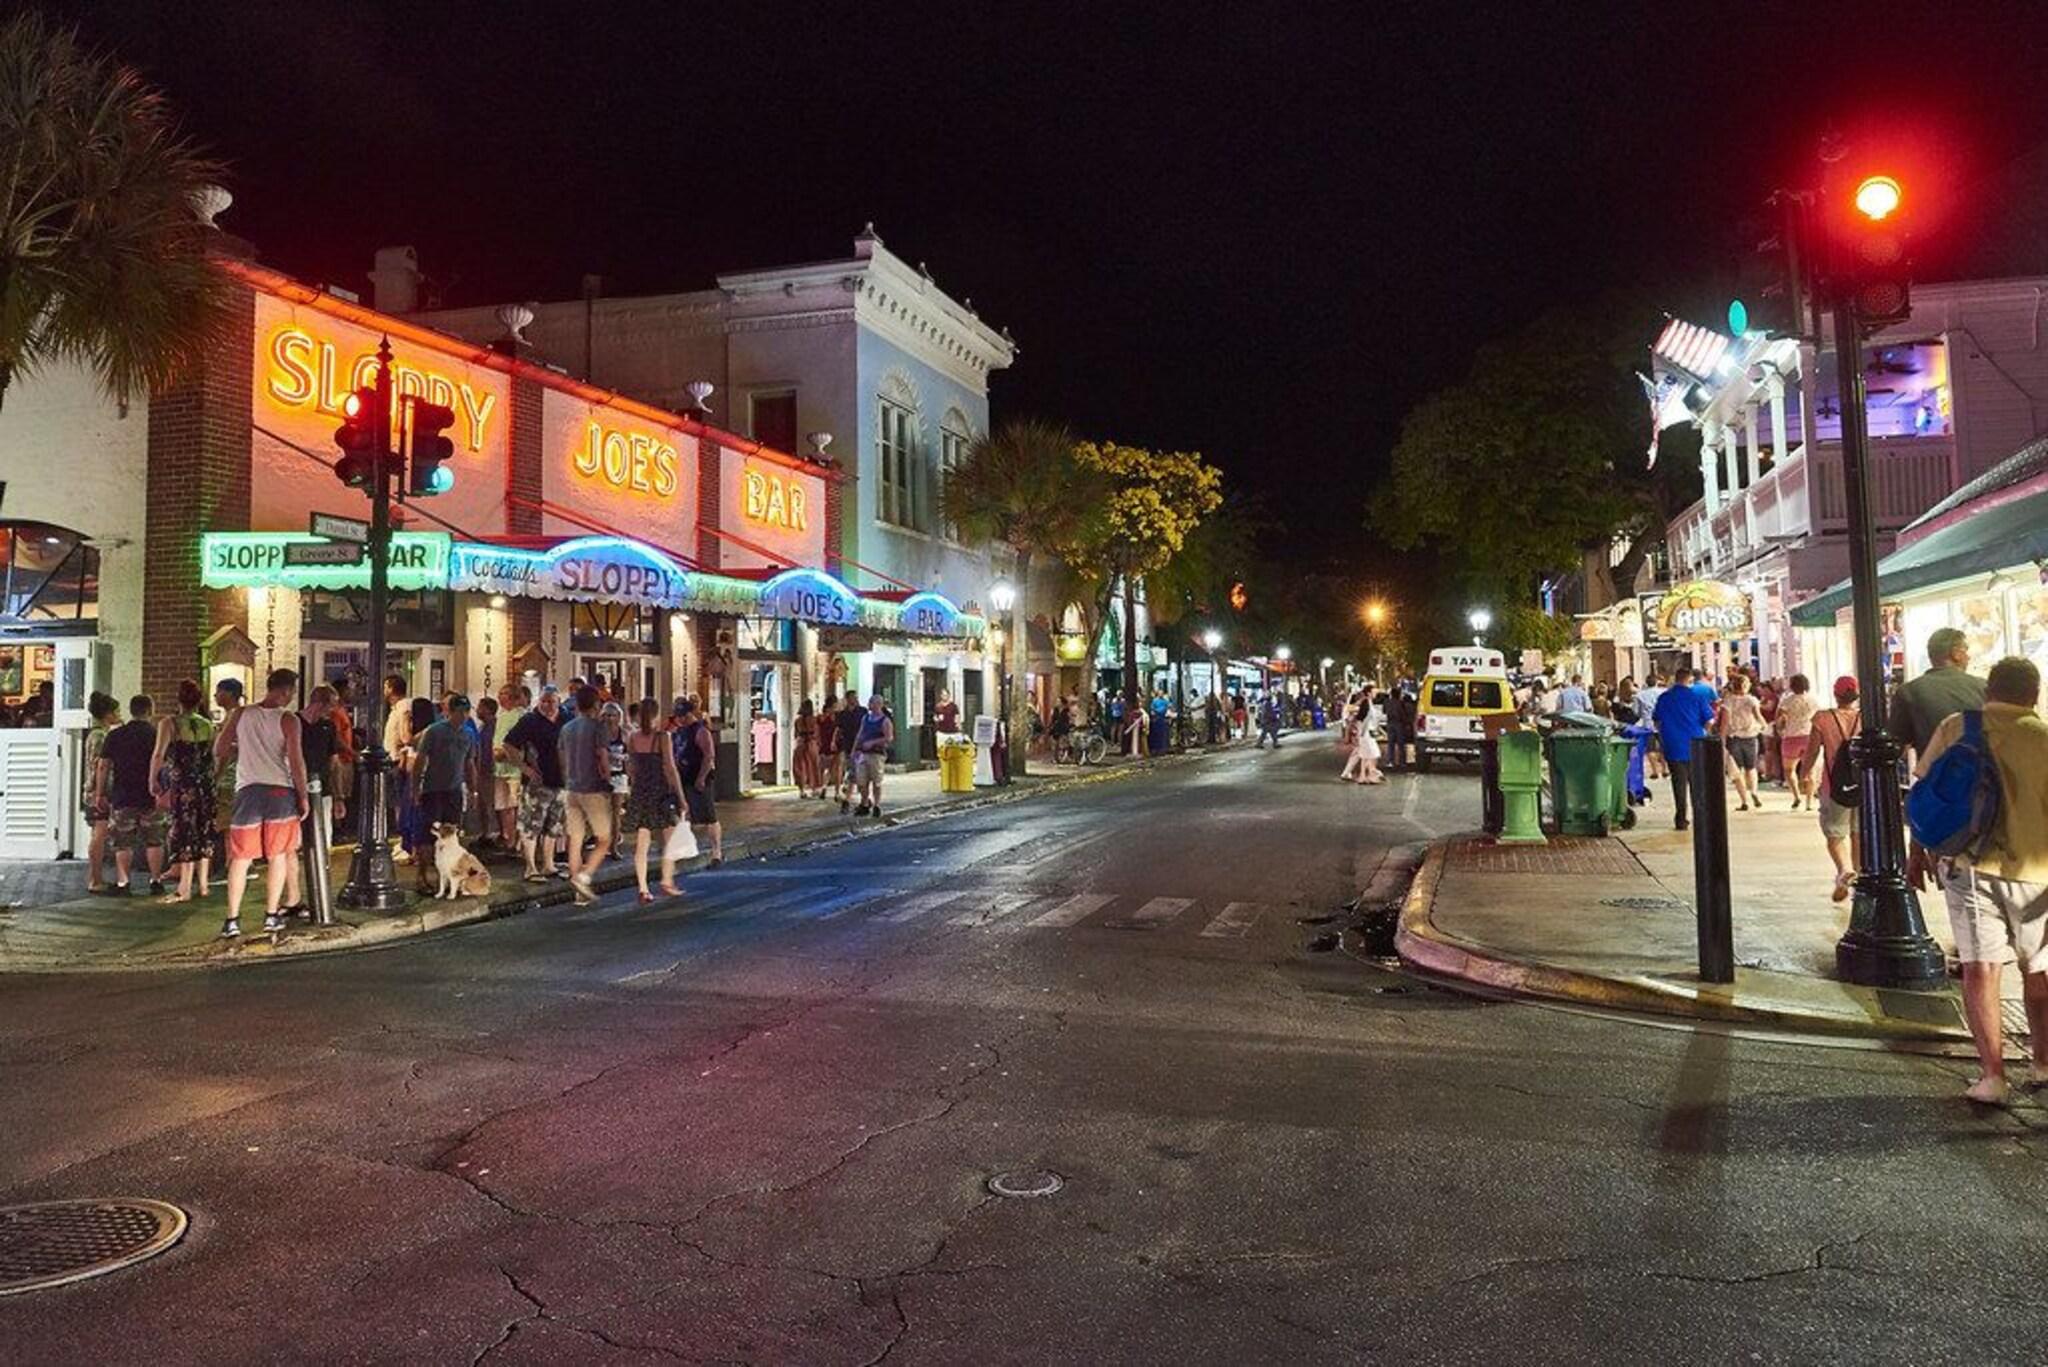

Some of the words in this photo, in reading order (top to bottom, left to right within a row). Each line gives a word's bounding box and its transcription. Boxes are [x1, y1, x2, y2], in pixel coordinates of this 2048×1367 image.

[574, 422, 677, 498] JOE'S
[745, 469, 808, 532] BAR
[212, 543, 285, 569] SLOPP
[390, 543, 427, 568] AR
[558, 557, 679, 598] SLOPPY
[789, 589, 844, 622] JOE'S
[1675, 605, 1745, 631] RICKS
[917, 608, 944, 633] BAR
[1451, 655, 1483, 667] TAXI
